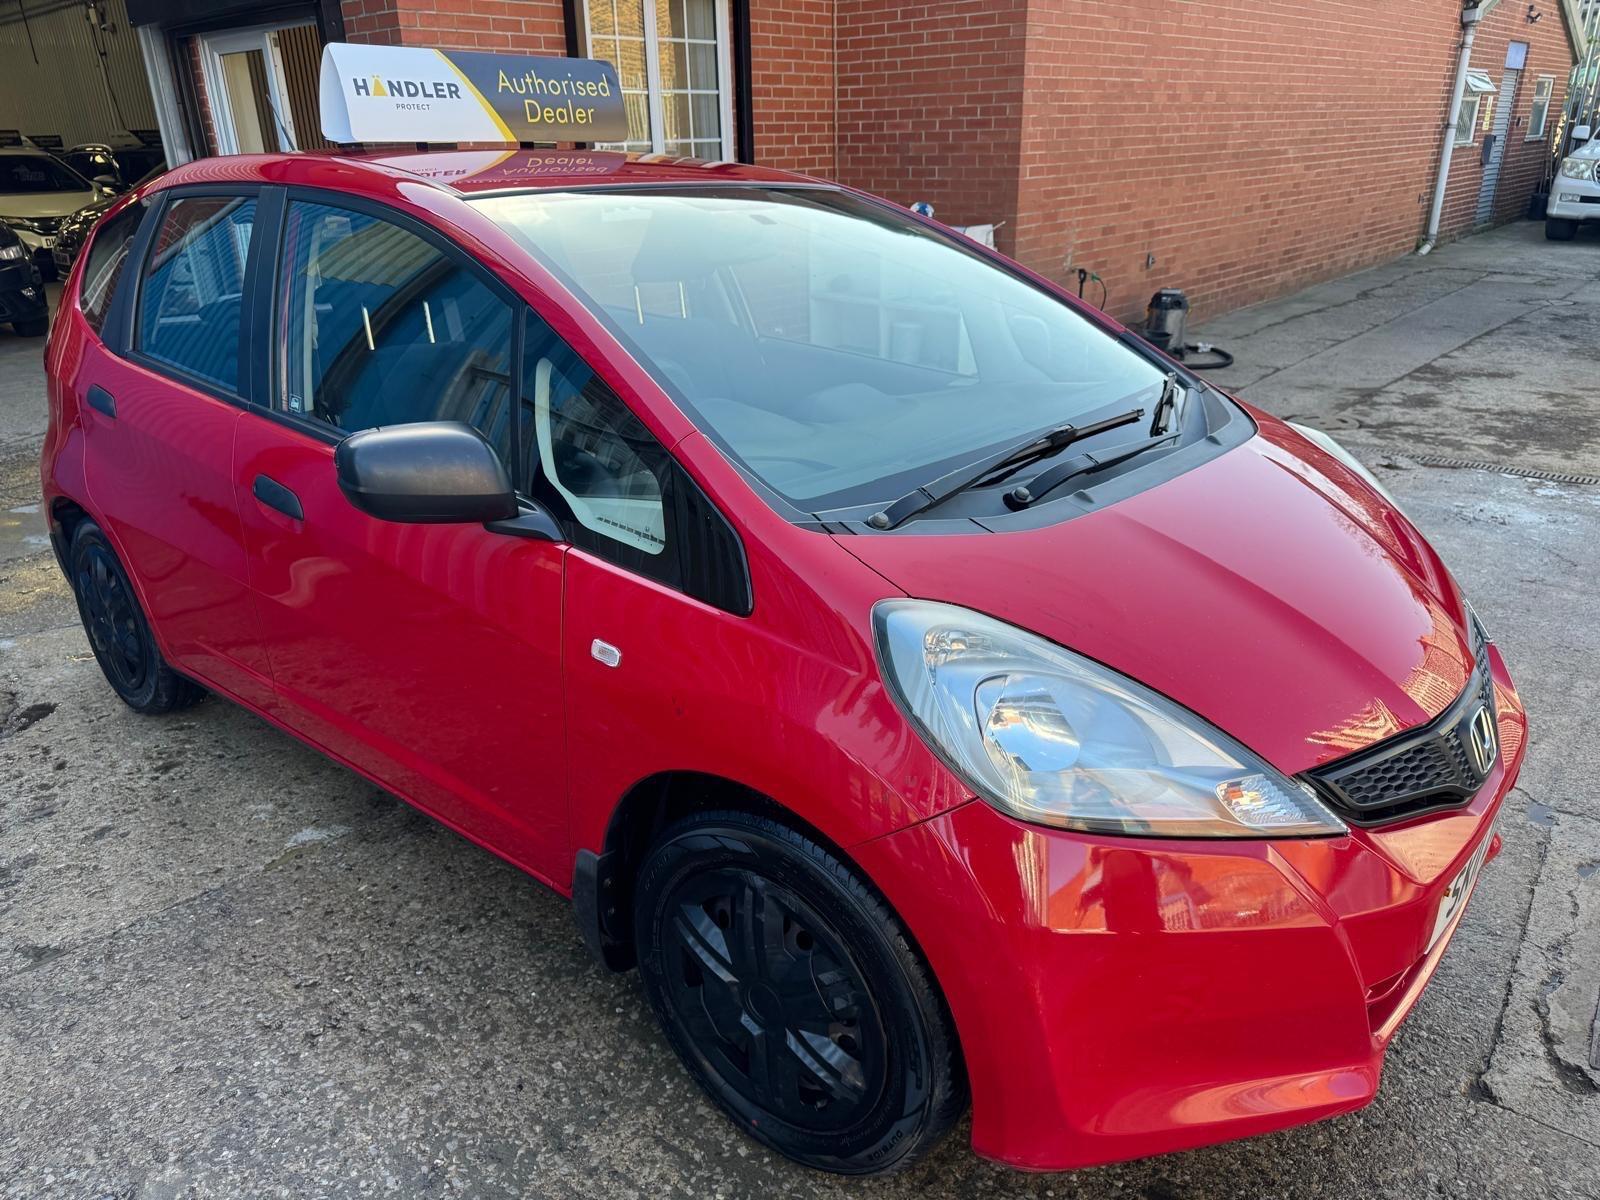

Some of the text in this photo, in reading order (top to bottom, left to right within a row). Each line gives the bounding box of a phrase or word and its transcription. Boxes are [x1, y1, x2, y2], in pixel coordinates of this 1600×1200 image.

[498, 69, 611, 97] Authorised
[396, 103, 431, 111] PROTECT
[524, 99, 594, 124] Dealer
